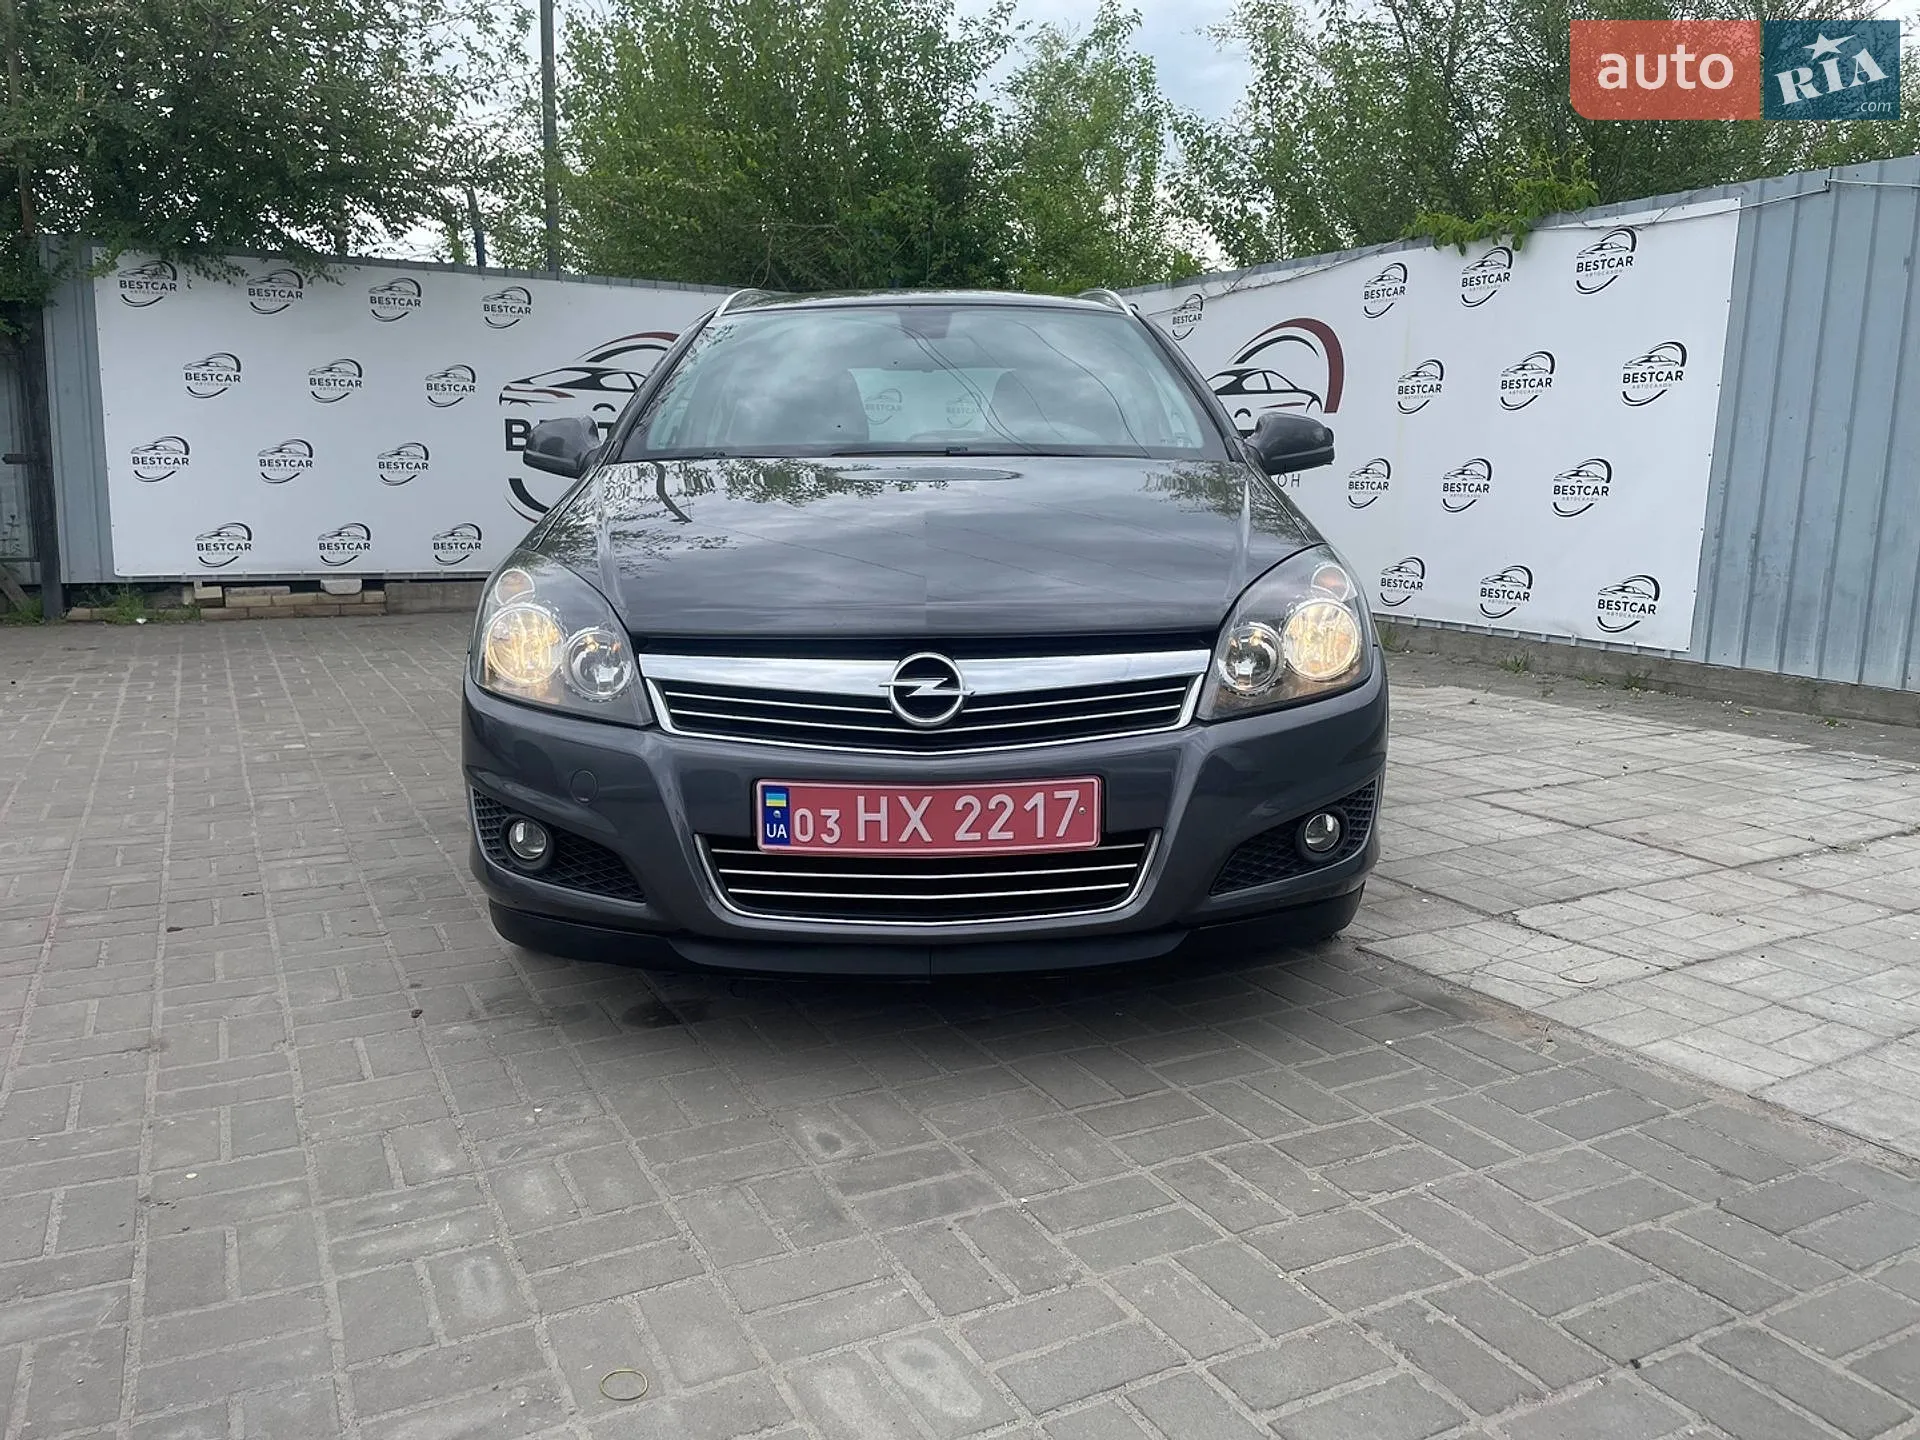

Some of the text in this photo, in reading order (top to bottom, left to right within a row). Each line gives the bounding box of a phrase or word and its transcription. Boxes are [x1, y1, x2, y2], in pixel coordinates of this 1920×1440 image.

[1576, 256, 1634, 272] BESTCAR
[119, 279, 177, 292] BESTCAR
[1461, 272, 1511, 287] BESTCAR
[248, 287, 303, 299] BESTCAR
[1363, 285, 1406, 300] BESTCAR
[369, 295, 422, 307] BESTCAR
[483, 303, 532, 315] BESTCAR
[185, 372, 241, 383] BESTCAR
[309, 377, 363, 388] BESTCAR
[1622, 370, 1684, 383] BESTCAR
[426, 382, 476, 393] BESTCAR
[1501, 377, 1552, 389] BESTCAR
[1397, 384, 1442, 395] BESTCAR
[132, 456, 190, 466] BESTCAR
[259, 458, 313, 468] BESTCAR
[378, 461, 429, 471] BESTCAR
[1348, 481, 1390, 491] BESTCAR
[1442, 482, 1490, 493] BESTCAR
[1553, 485, 1610, 496] BESTCAR
[196, 542, 252, 552] BESTCAR
[318, 541, 371, 551] BESTCAR
[433, 541, 482, 551] BESTCAR
[1380, 578, 1423, 590] BESTCAR
[1480, 587, 1531, 602] BESTCAR
[1597, 598, 1657, 615] BESTCAR
[793, 789, 1080, 845] 03 HX 2217
[766, 823, 788, 839] UA
